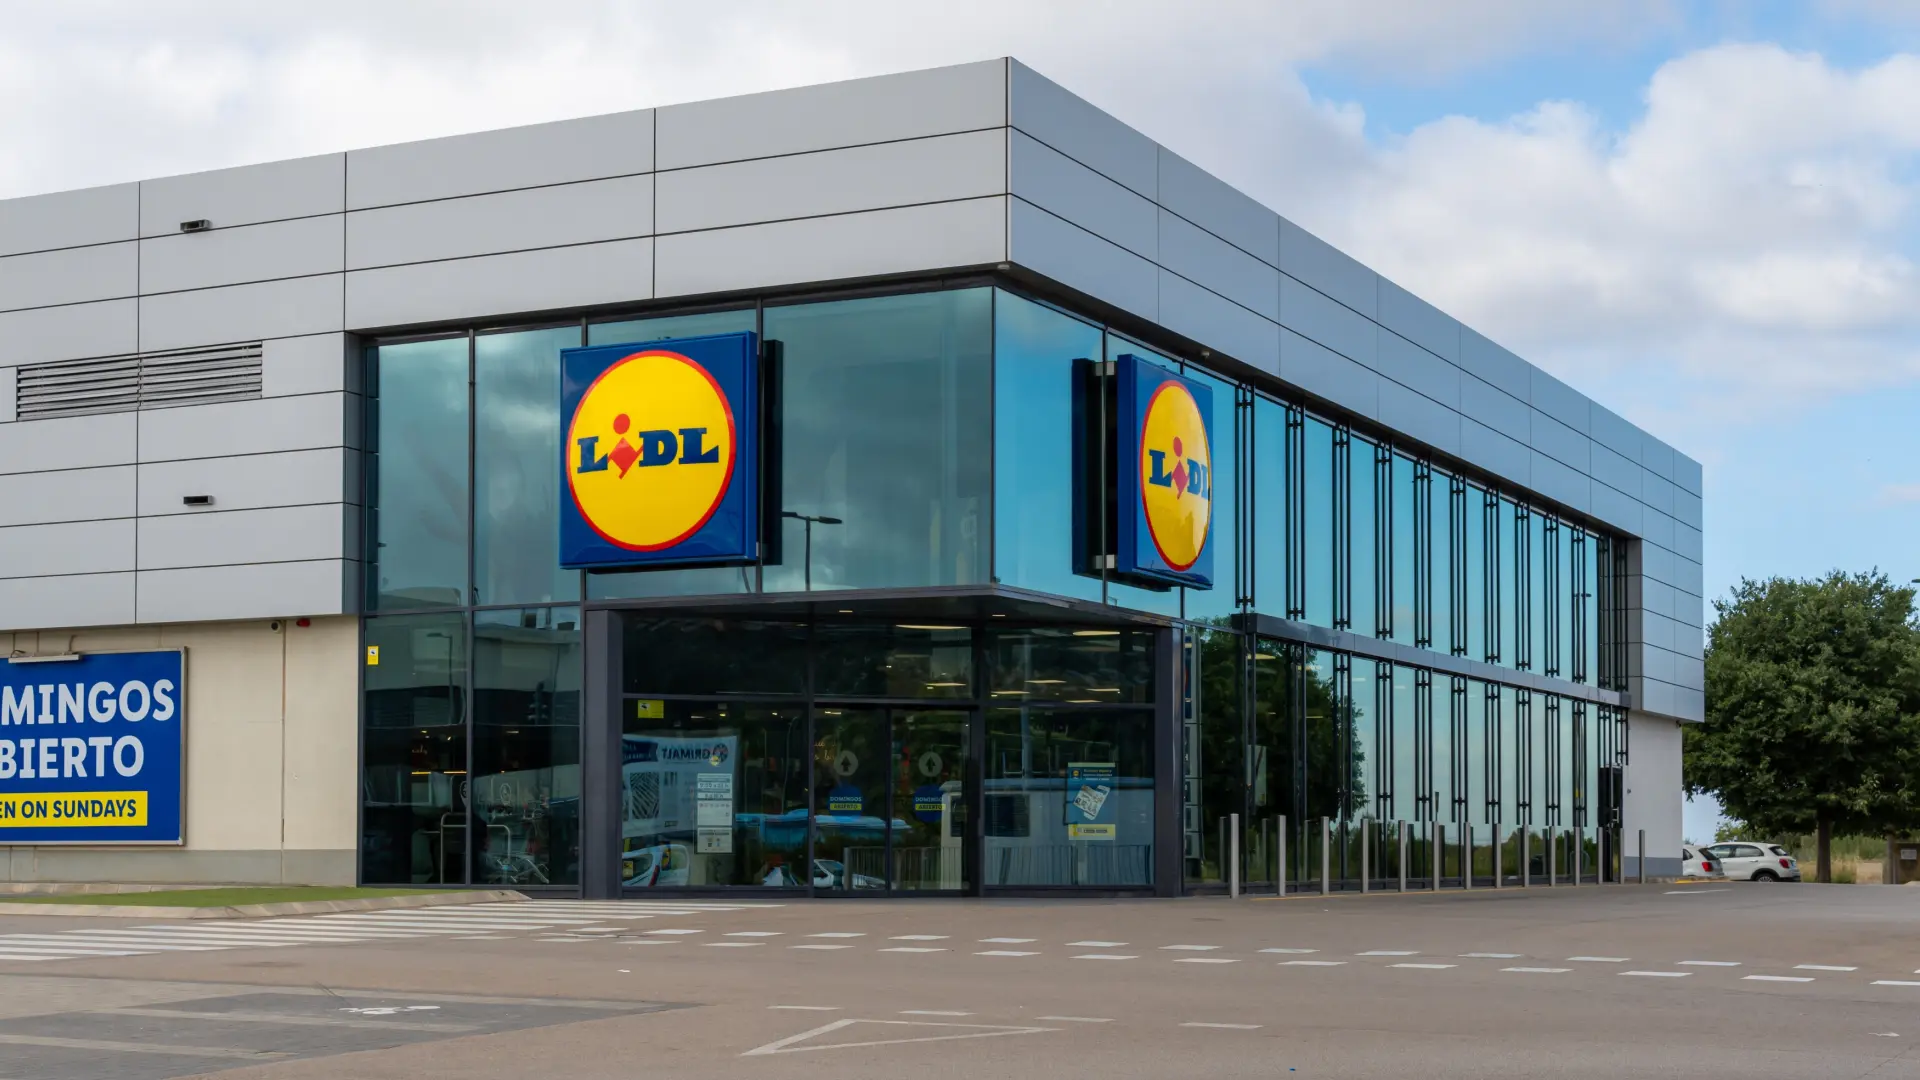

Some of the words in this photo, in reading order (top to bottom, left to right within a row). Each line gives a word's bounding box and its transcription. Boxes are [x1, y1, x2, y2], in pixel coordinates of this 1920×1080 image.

[1, 679, 175, 725] MINGOS
[0, 735, 145, 780] BIERTO
[21, 800, 48, 819] ON
[53, 799, 137, 819] SUNDAYS
